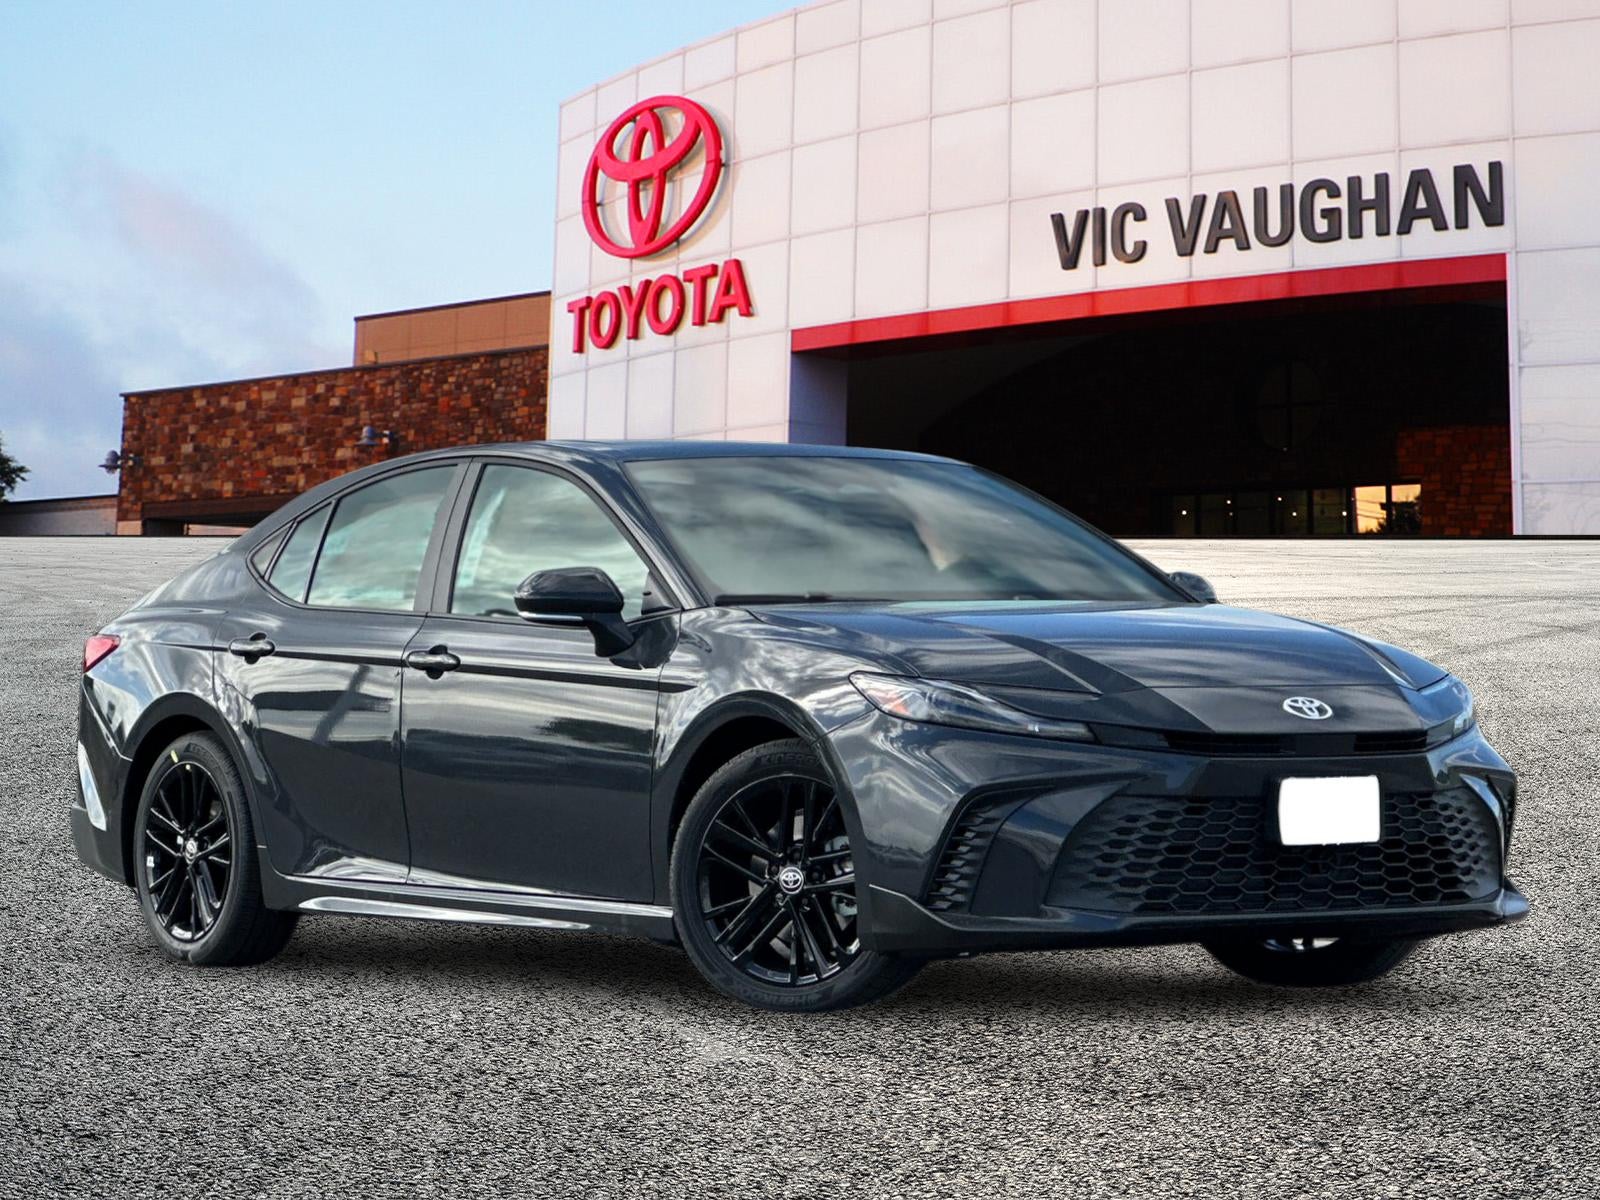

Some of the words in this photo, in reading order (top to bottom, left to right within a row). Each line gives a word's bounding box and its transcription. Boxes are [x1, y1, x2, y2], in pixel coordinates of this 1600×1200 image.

[1050, 202, 1148, 270] VIC
[1165, 161, 1505, 257] VAUGHAN
[567, 258, 754, 353] TOYOTA
